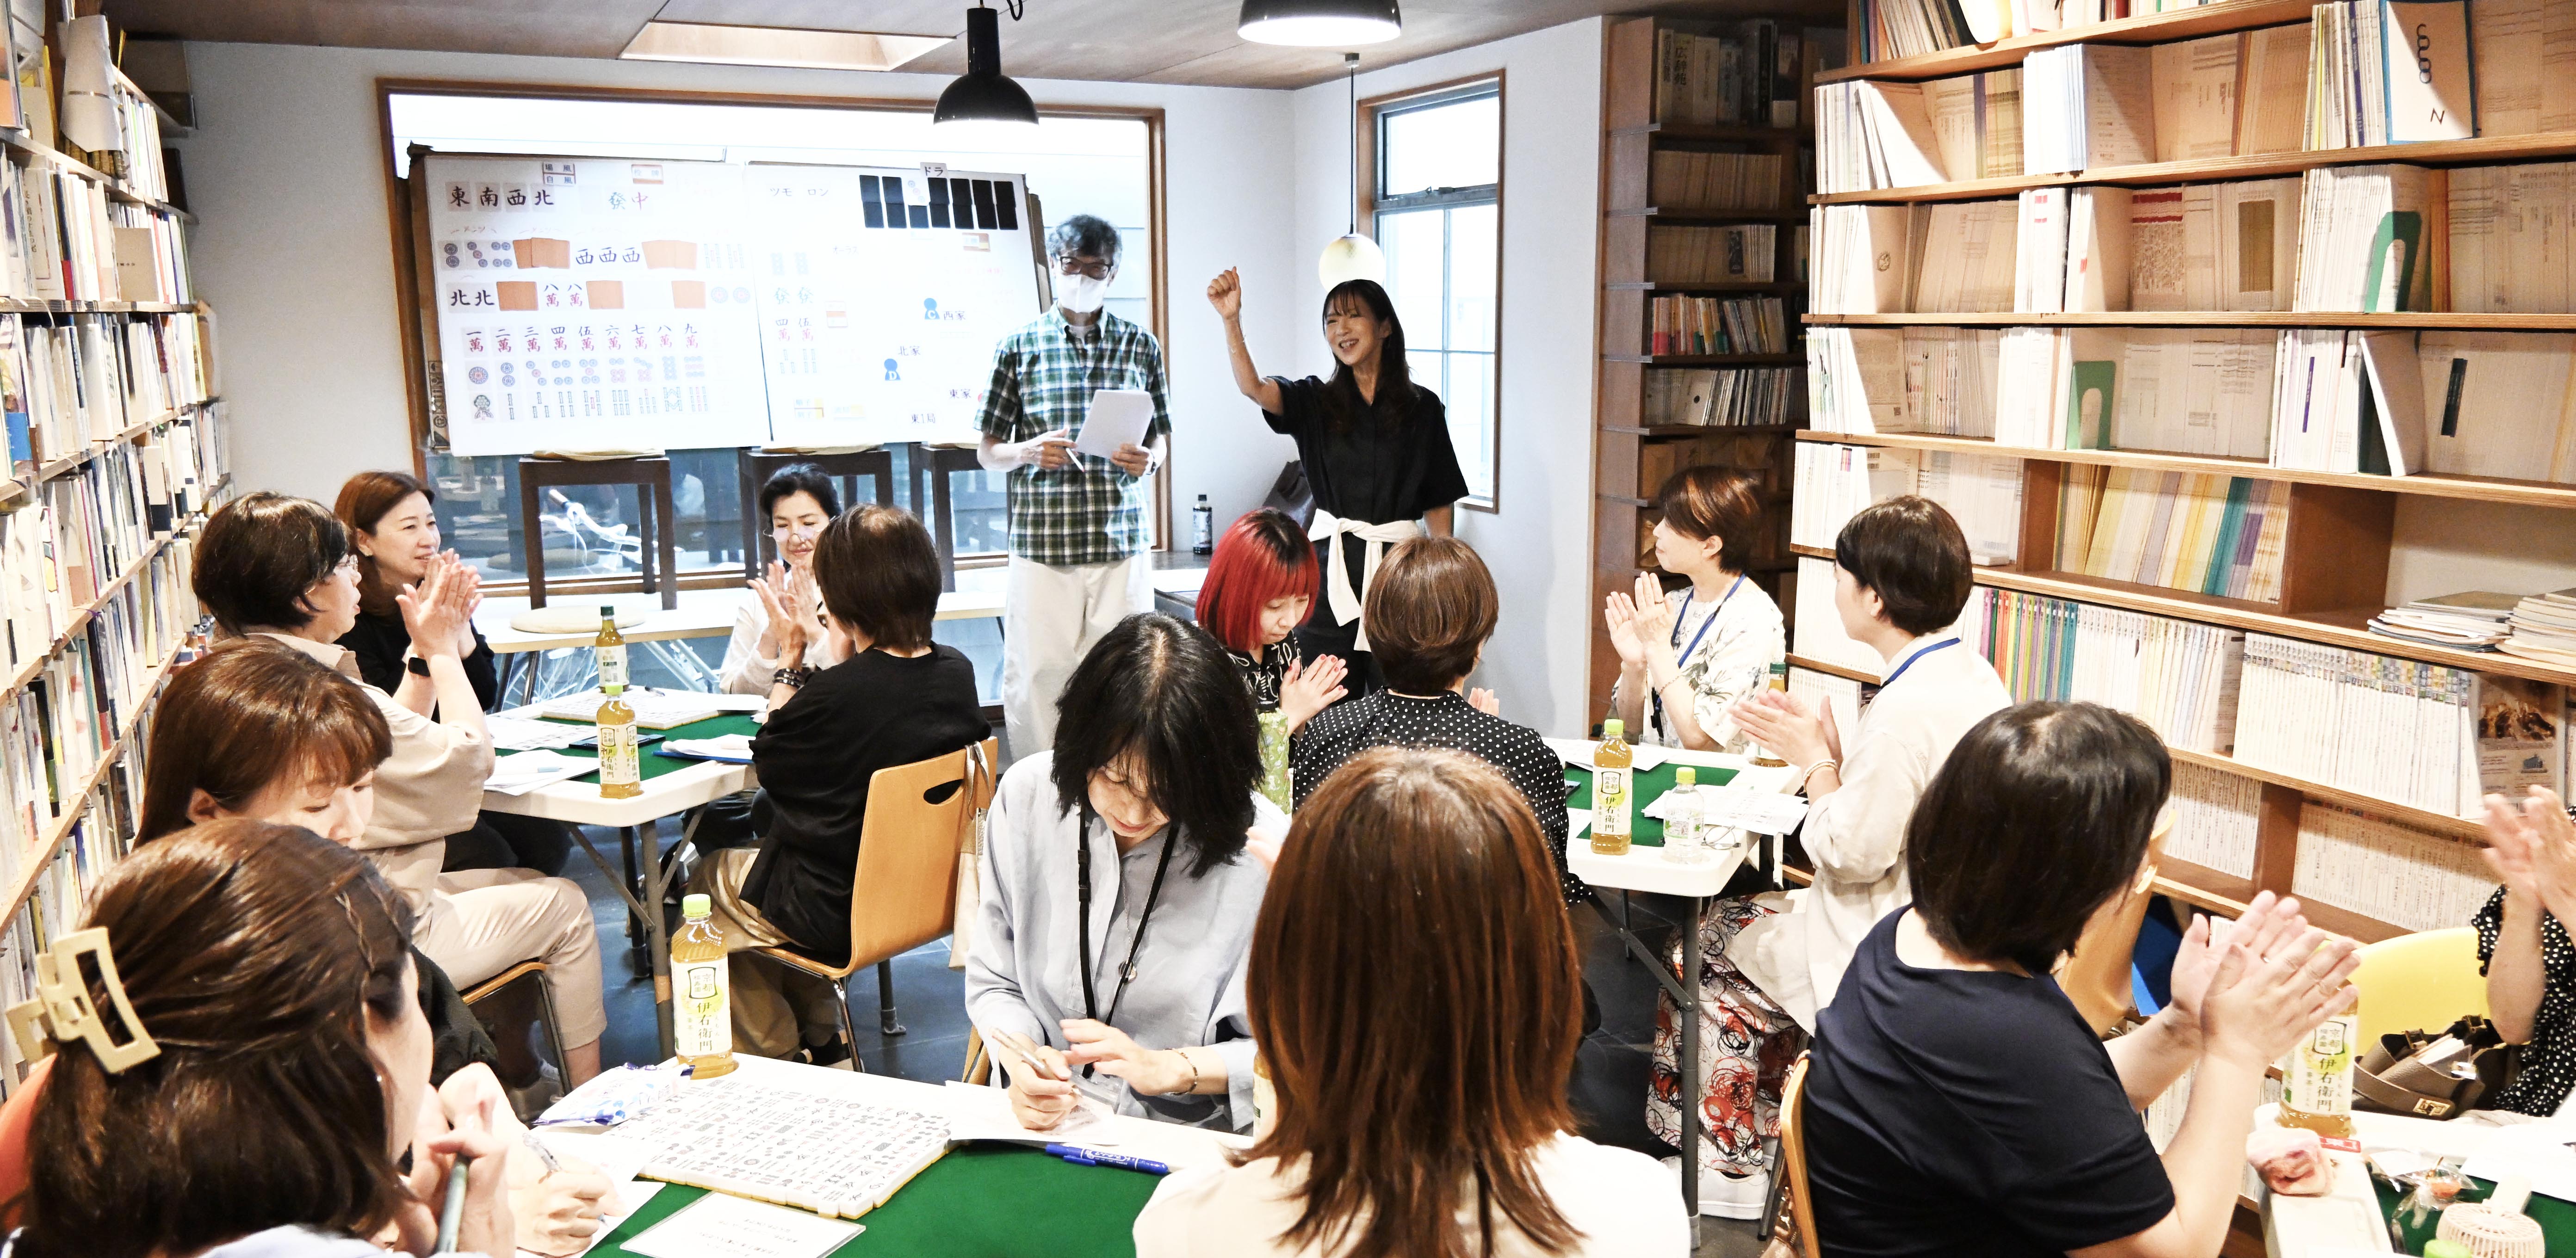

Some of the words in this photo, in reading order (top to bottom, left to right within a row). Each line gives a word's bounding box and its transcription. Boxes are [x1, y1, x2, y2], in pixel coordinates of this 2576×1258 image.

[924, 166, 943, 176] ドラ
[769, 187, 793, 197] ツモ
[807, 187, 829, 197] ロン
[832, 245, 859, 256] オーラス
[943, 311, 966, 321] 西家
[898, 345, 921, 357] 北家
[888, 371, 898, 380] D
[949, 388, 972, 400] 東家
[911, 413, 936, 425] 東1局
[1605, 796, 1616, 832] 伊右衛門
[702, 973, 712, 992] 京都
[697, 1002, 713, 1051] 伊右衛門
[2329, 1028, 2341, 1048] 京都
[2317, 1058, 2337, 1111] 伊右衛門
